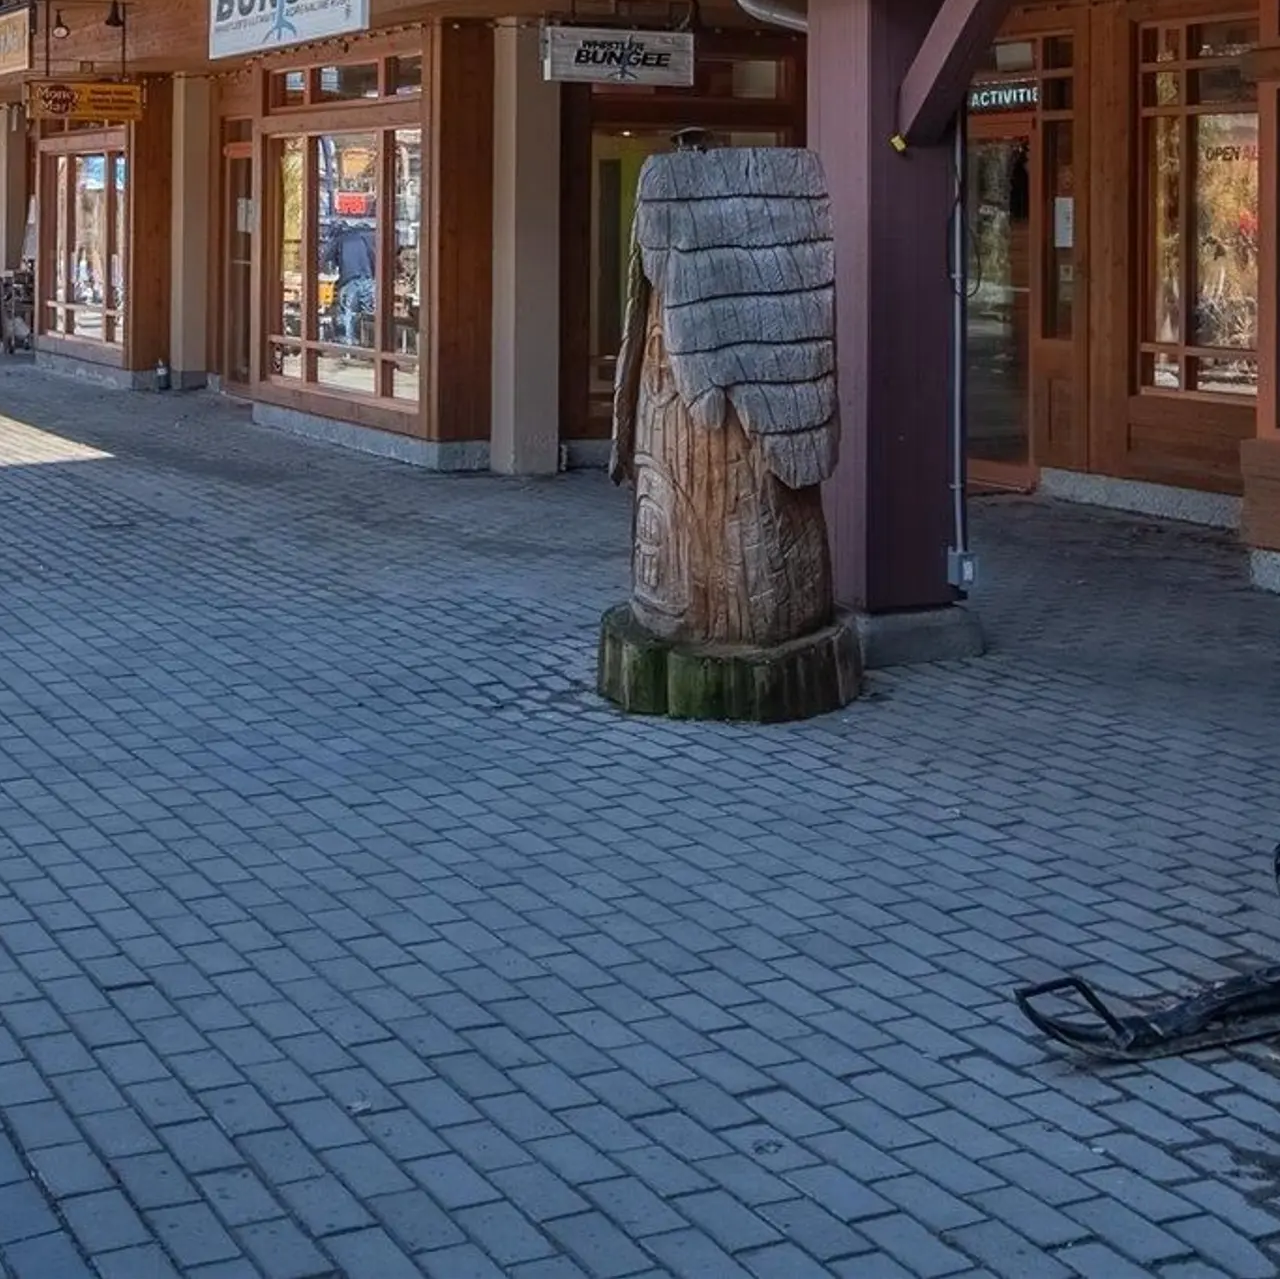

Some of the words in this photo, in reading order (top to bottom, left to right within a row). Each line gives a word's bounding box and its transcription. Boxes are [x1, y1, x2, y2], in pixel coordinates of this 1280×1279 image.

[581, 39, 644, 51] WHISTLER
[575, 49, 671, 67] BUNGEE
[36, 85, 80, 102] Money
[1204, 145, 1240, 161] OPEN
